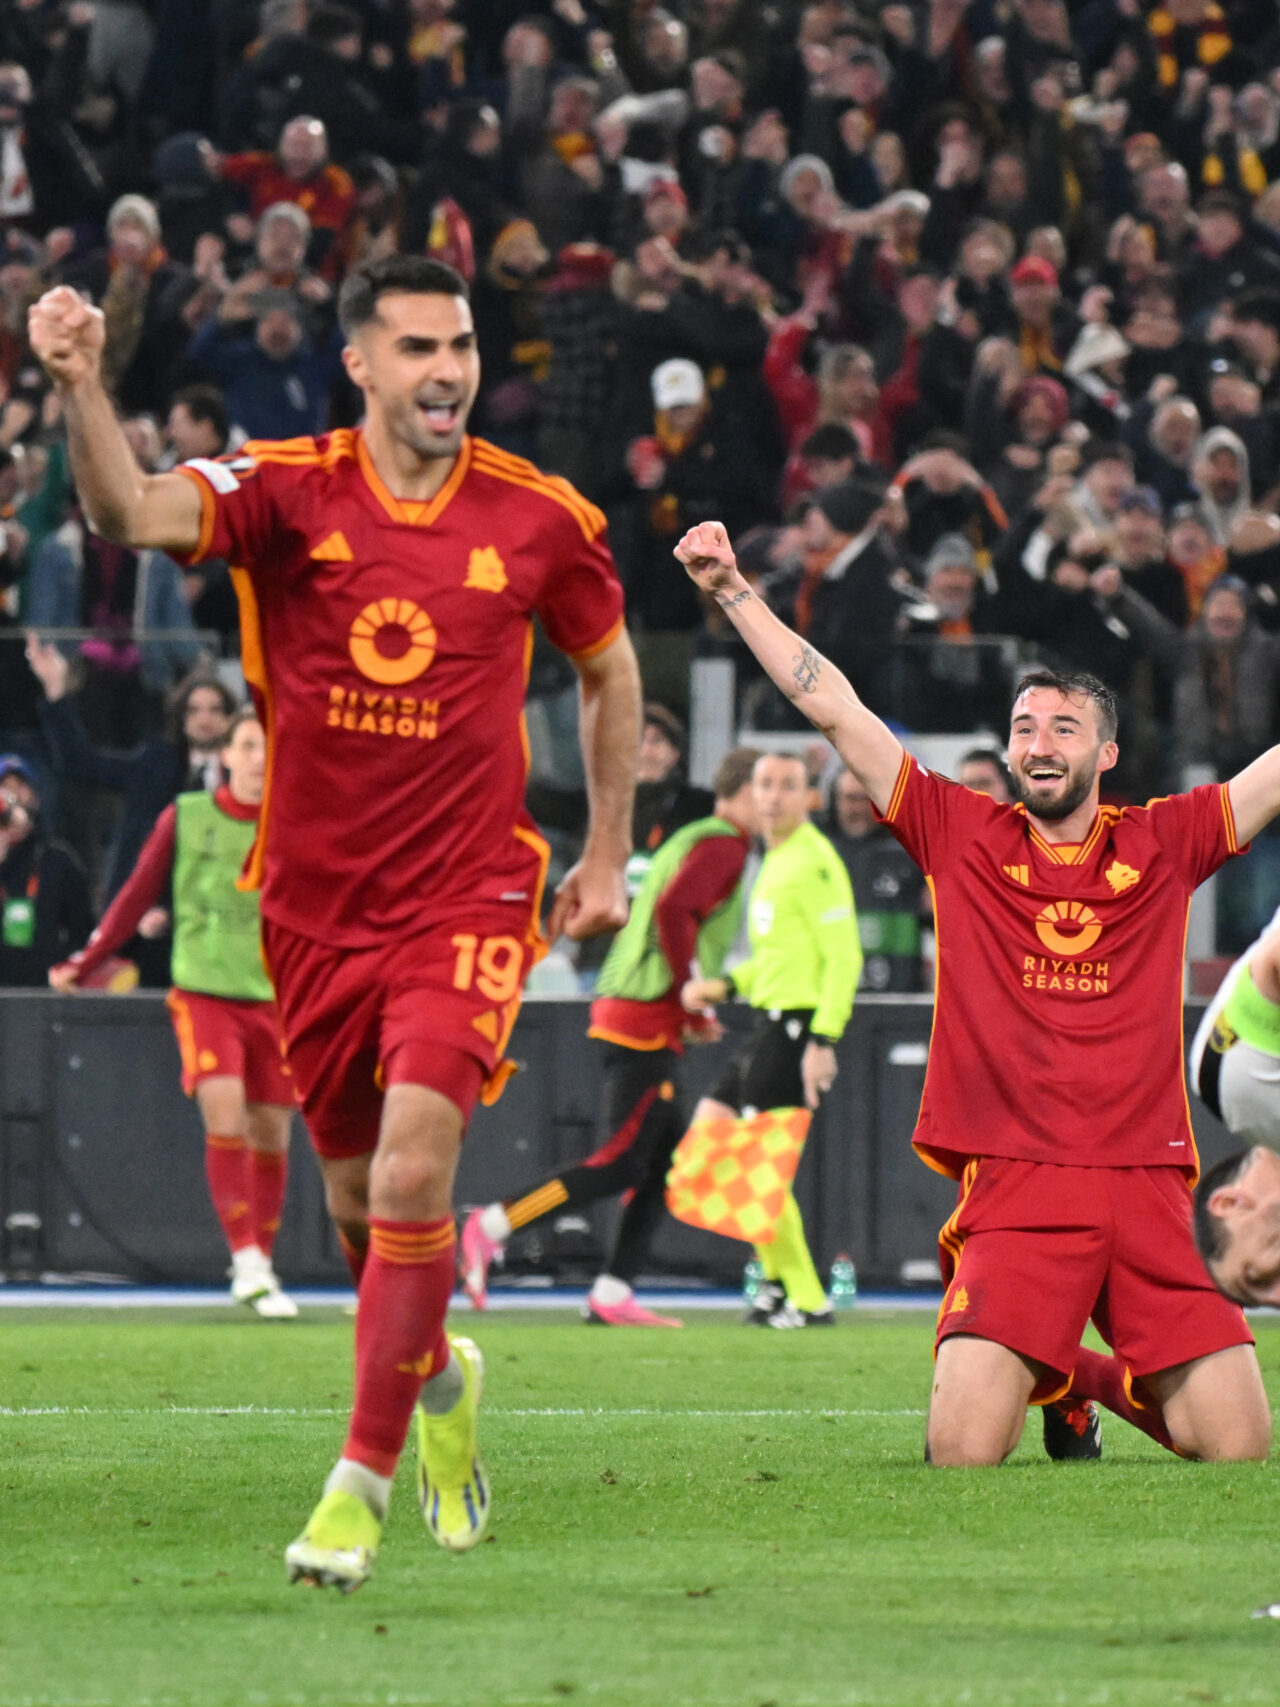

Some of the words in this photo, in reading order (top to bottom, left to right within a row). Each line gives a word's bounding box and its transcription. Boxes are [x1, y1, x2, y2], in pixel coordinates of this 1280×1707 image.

[329, 685, 440, 717] RIYADH
[327, 707, 438, 739] SEASON
[451, 933, 524, 1002] 19
[1024, 956, 1109, 977] RIYADH
[1022, 974, 1108, 993] SEASON
